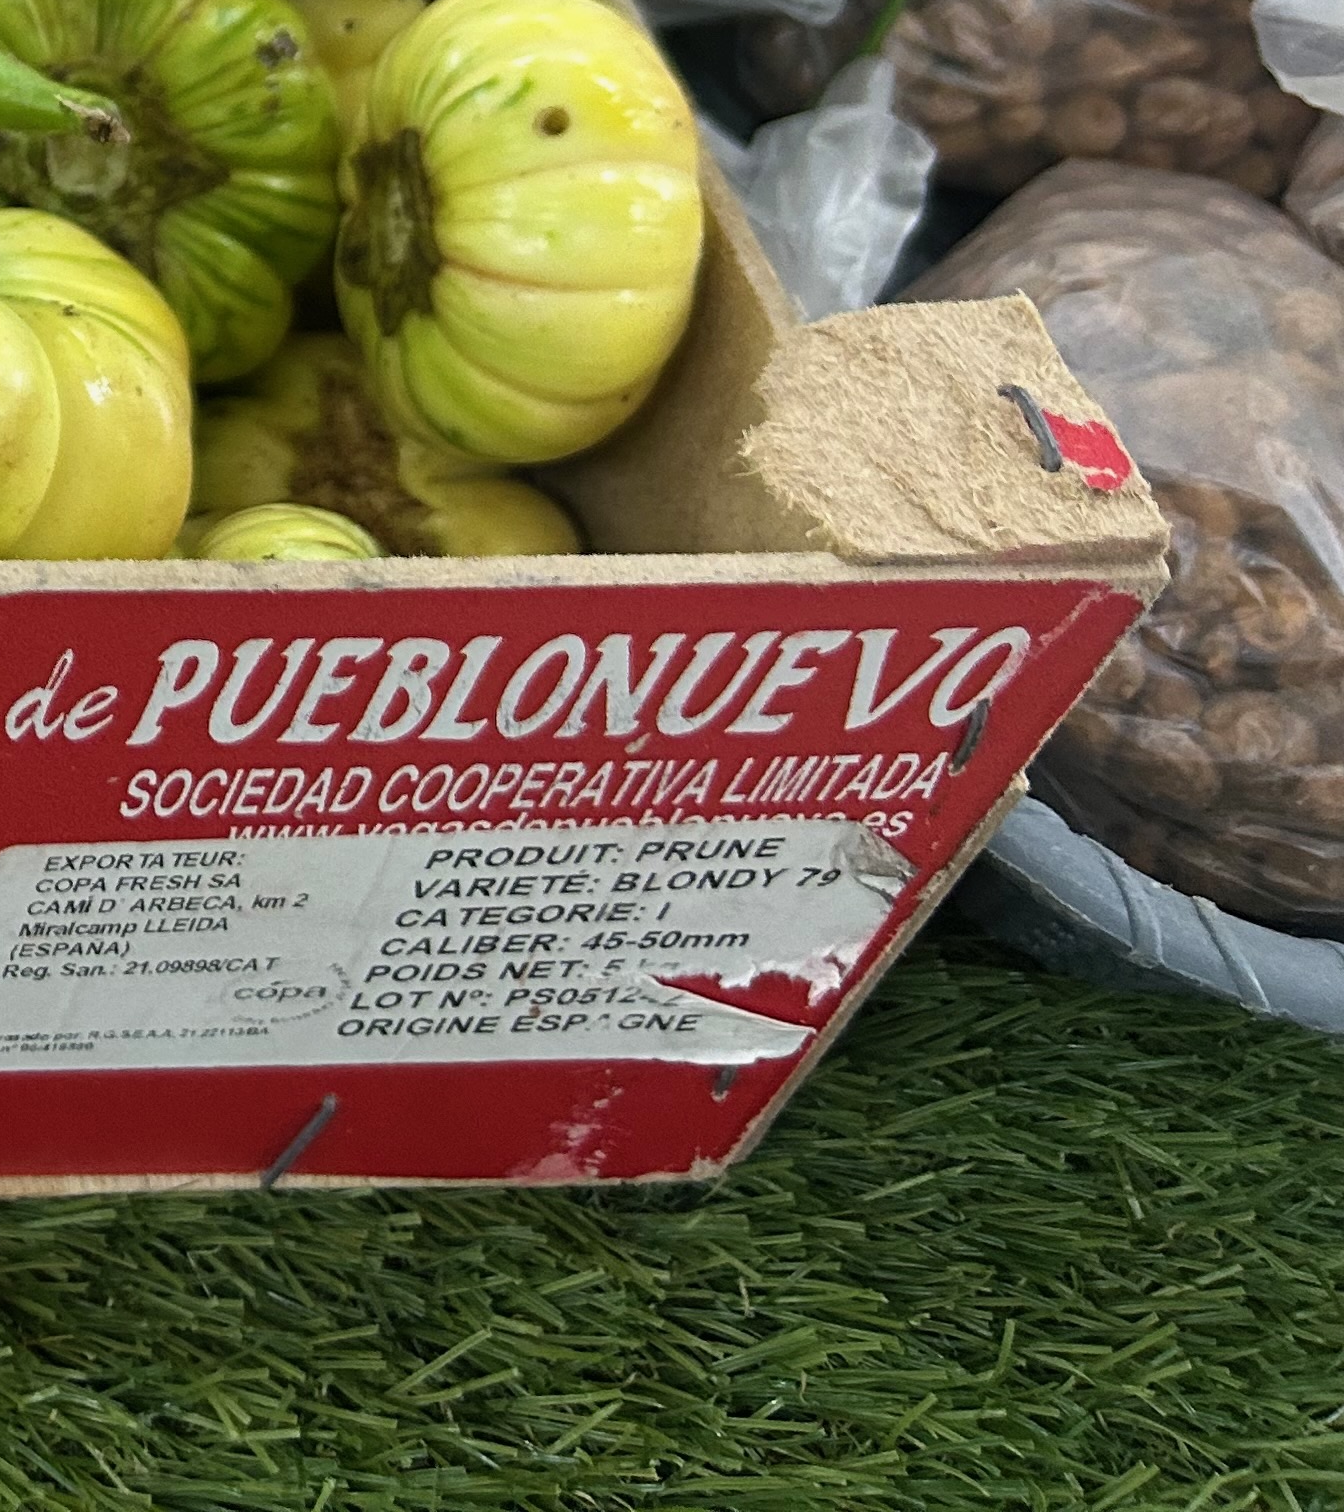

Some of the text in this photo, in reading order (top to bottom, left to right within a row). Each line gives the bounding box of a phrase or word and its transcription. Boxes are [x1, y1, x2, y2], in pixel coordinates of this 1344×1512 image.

[5, 648, 118, 742] de
[126, 626, 1031, 746] PUEBLONUEVO
[119, 752, 953, 819] SOCIEDAD COOPERATIVA LIMITADA
[424, 836, 787, 870] PRODUIT: PRUNE
[35, 872, 242, 894] COPA FRESH SA
[412, 866, 842, 900] VARIETÉ: BLONDY 79
[251, 894, 286, 910] km
[292, 893, 310, 909] 2
[18, 916, 230, 940] Miralcamp LLEIDA
[379, 929, 751, 957] CALIBER: 45-50mm
[2, 963, 51, 981] Reg.
[363, 961, 486, 984] POIDS
[498, 958, 590, 982] NET:
[350, 988, 432, 1011] LOT
[337, 1014, 501, 1038] ORIGINE
